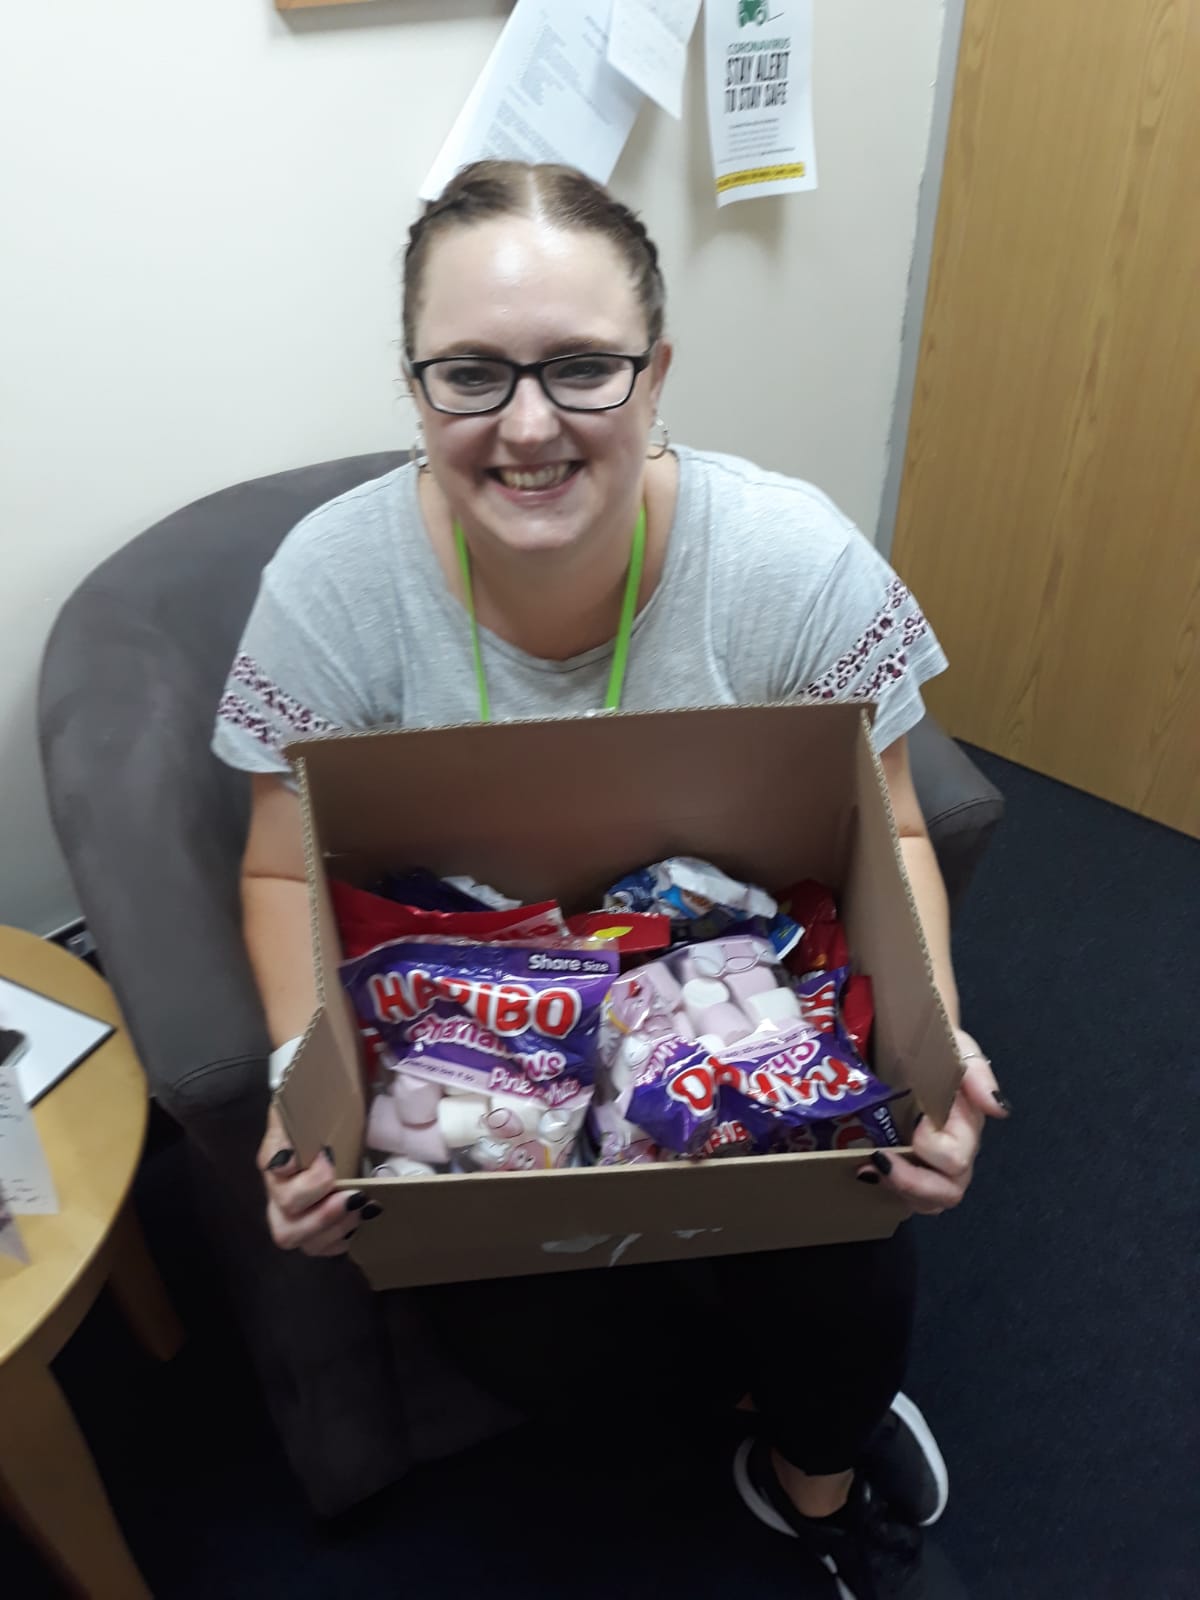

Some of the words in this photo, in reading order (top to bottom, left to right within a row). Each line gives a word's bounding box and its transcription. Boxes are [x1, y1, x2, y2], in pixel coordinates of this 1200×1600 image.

[726, 55, 753, 86] STAY
[756, 51, 789, 82] ALERT
[724, 88, 738, 113] TO
[739, 85, 761, 111] STAY
[764, 80, 788, 107] SAFE
[528, 953, 581, 972] Share
[582, 959, 609, 973] Size
